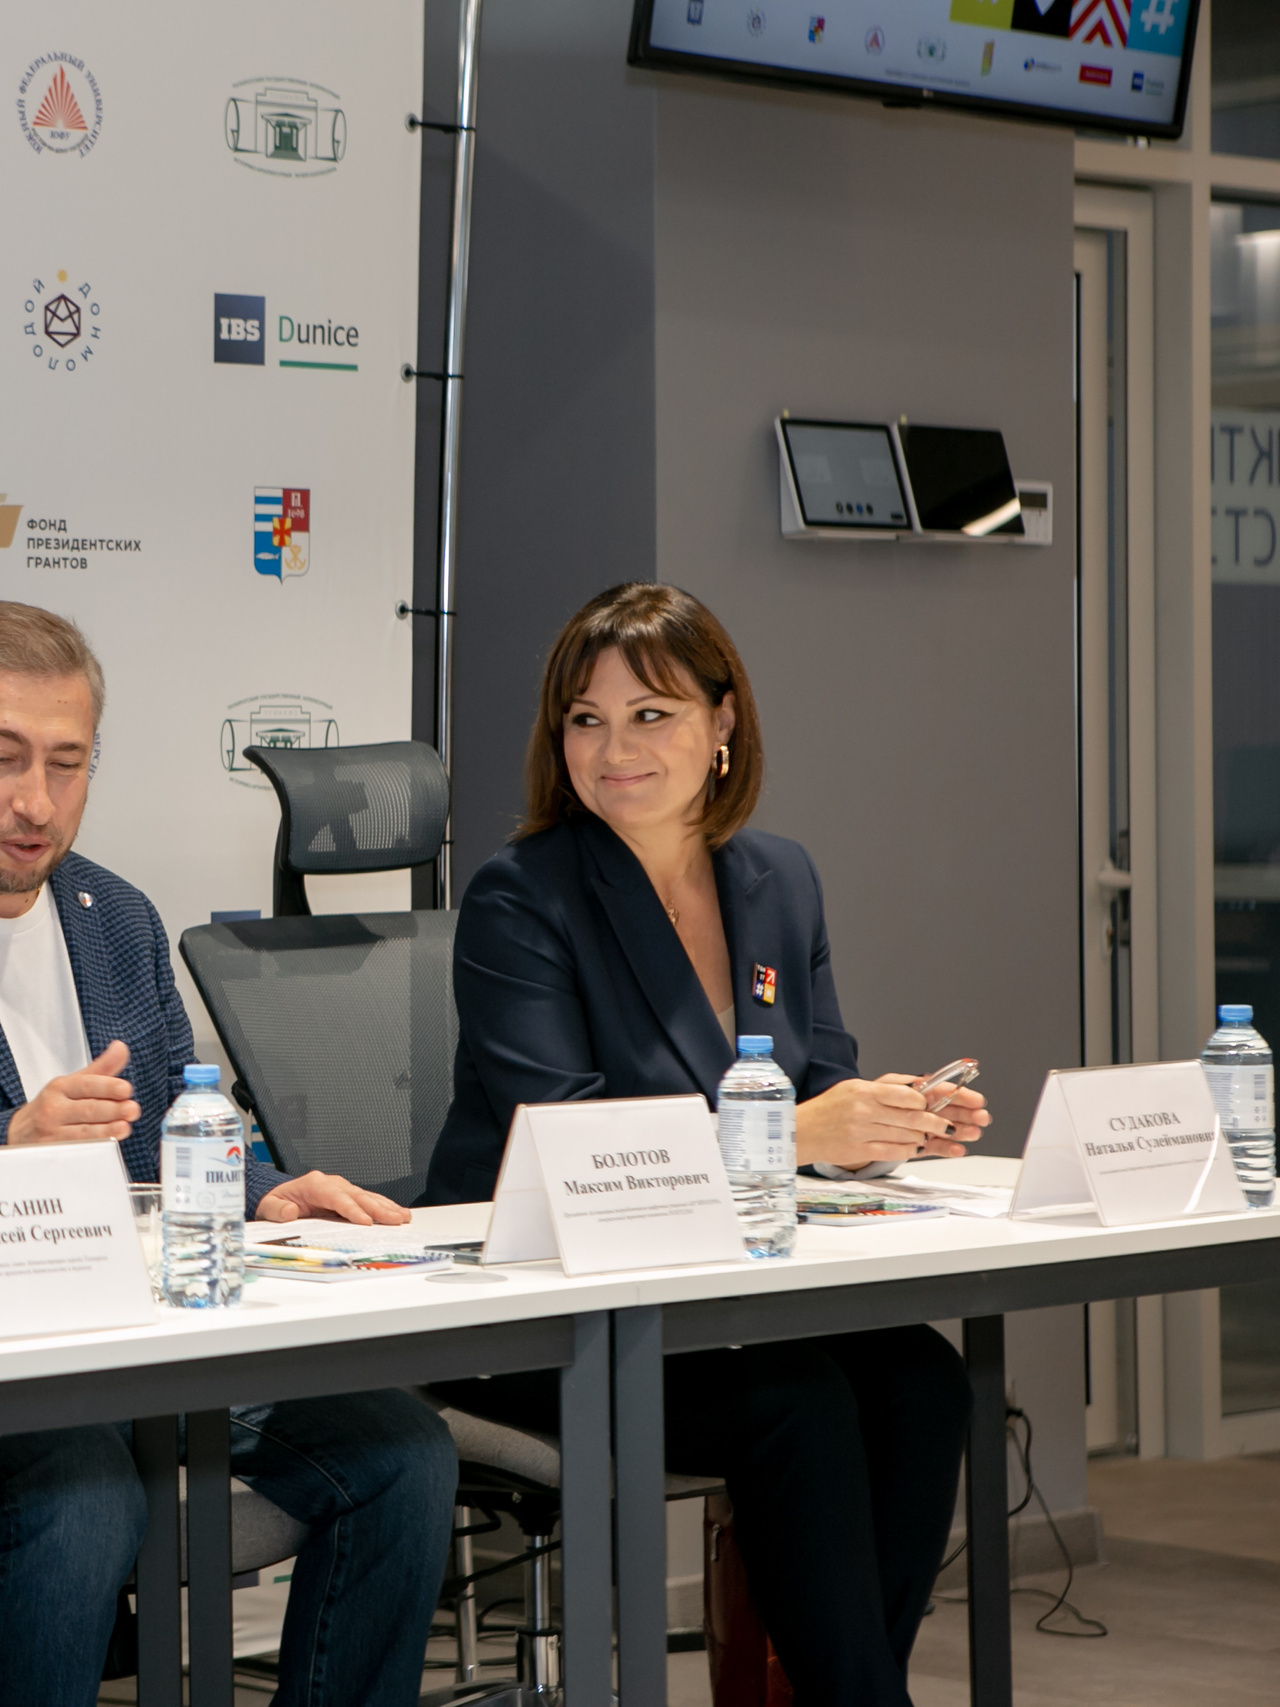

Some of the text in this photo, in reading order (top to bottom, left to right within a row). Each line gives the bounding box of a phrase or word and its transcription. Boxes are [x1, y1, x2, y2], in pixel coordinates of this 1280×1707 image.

[50, 130, 71, 141] ЮФУ
[219, 317, 261, 342] IBS
[278, 315, 360, 347] Dunice
[27, 518, 68, 533] ФОНД
[26, 537, 142, 552] ПРЕЗИДЕНТСКИХ
[27, 556, 88, 569] ГРАНТОВ
[1109, 1112, 1182, 1132] СУДАКОВА
[591, 1149, 671, 1170] БОЛОТОВ
[1084, 1142, 1135, 1157] Наталья
[563, 1173, 710, 1196] Максим Викторович
[30, 1224, 113, 1245] Сергеевич
